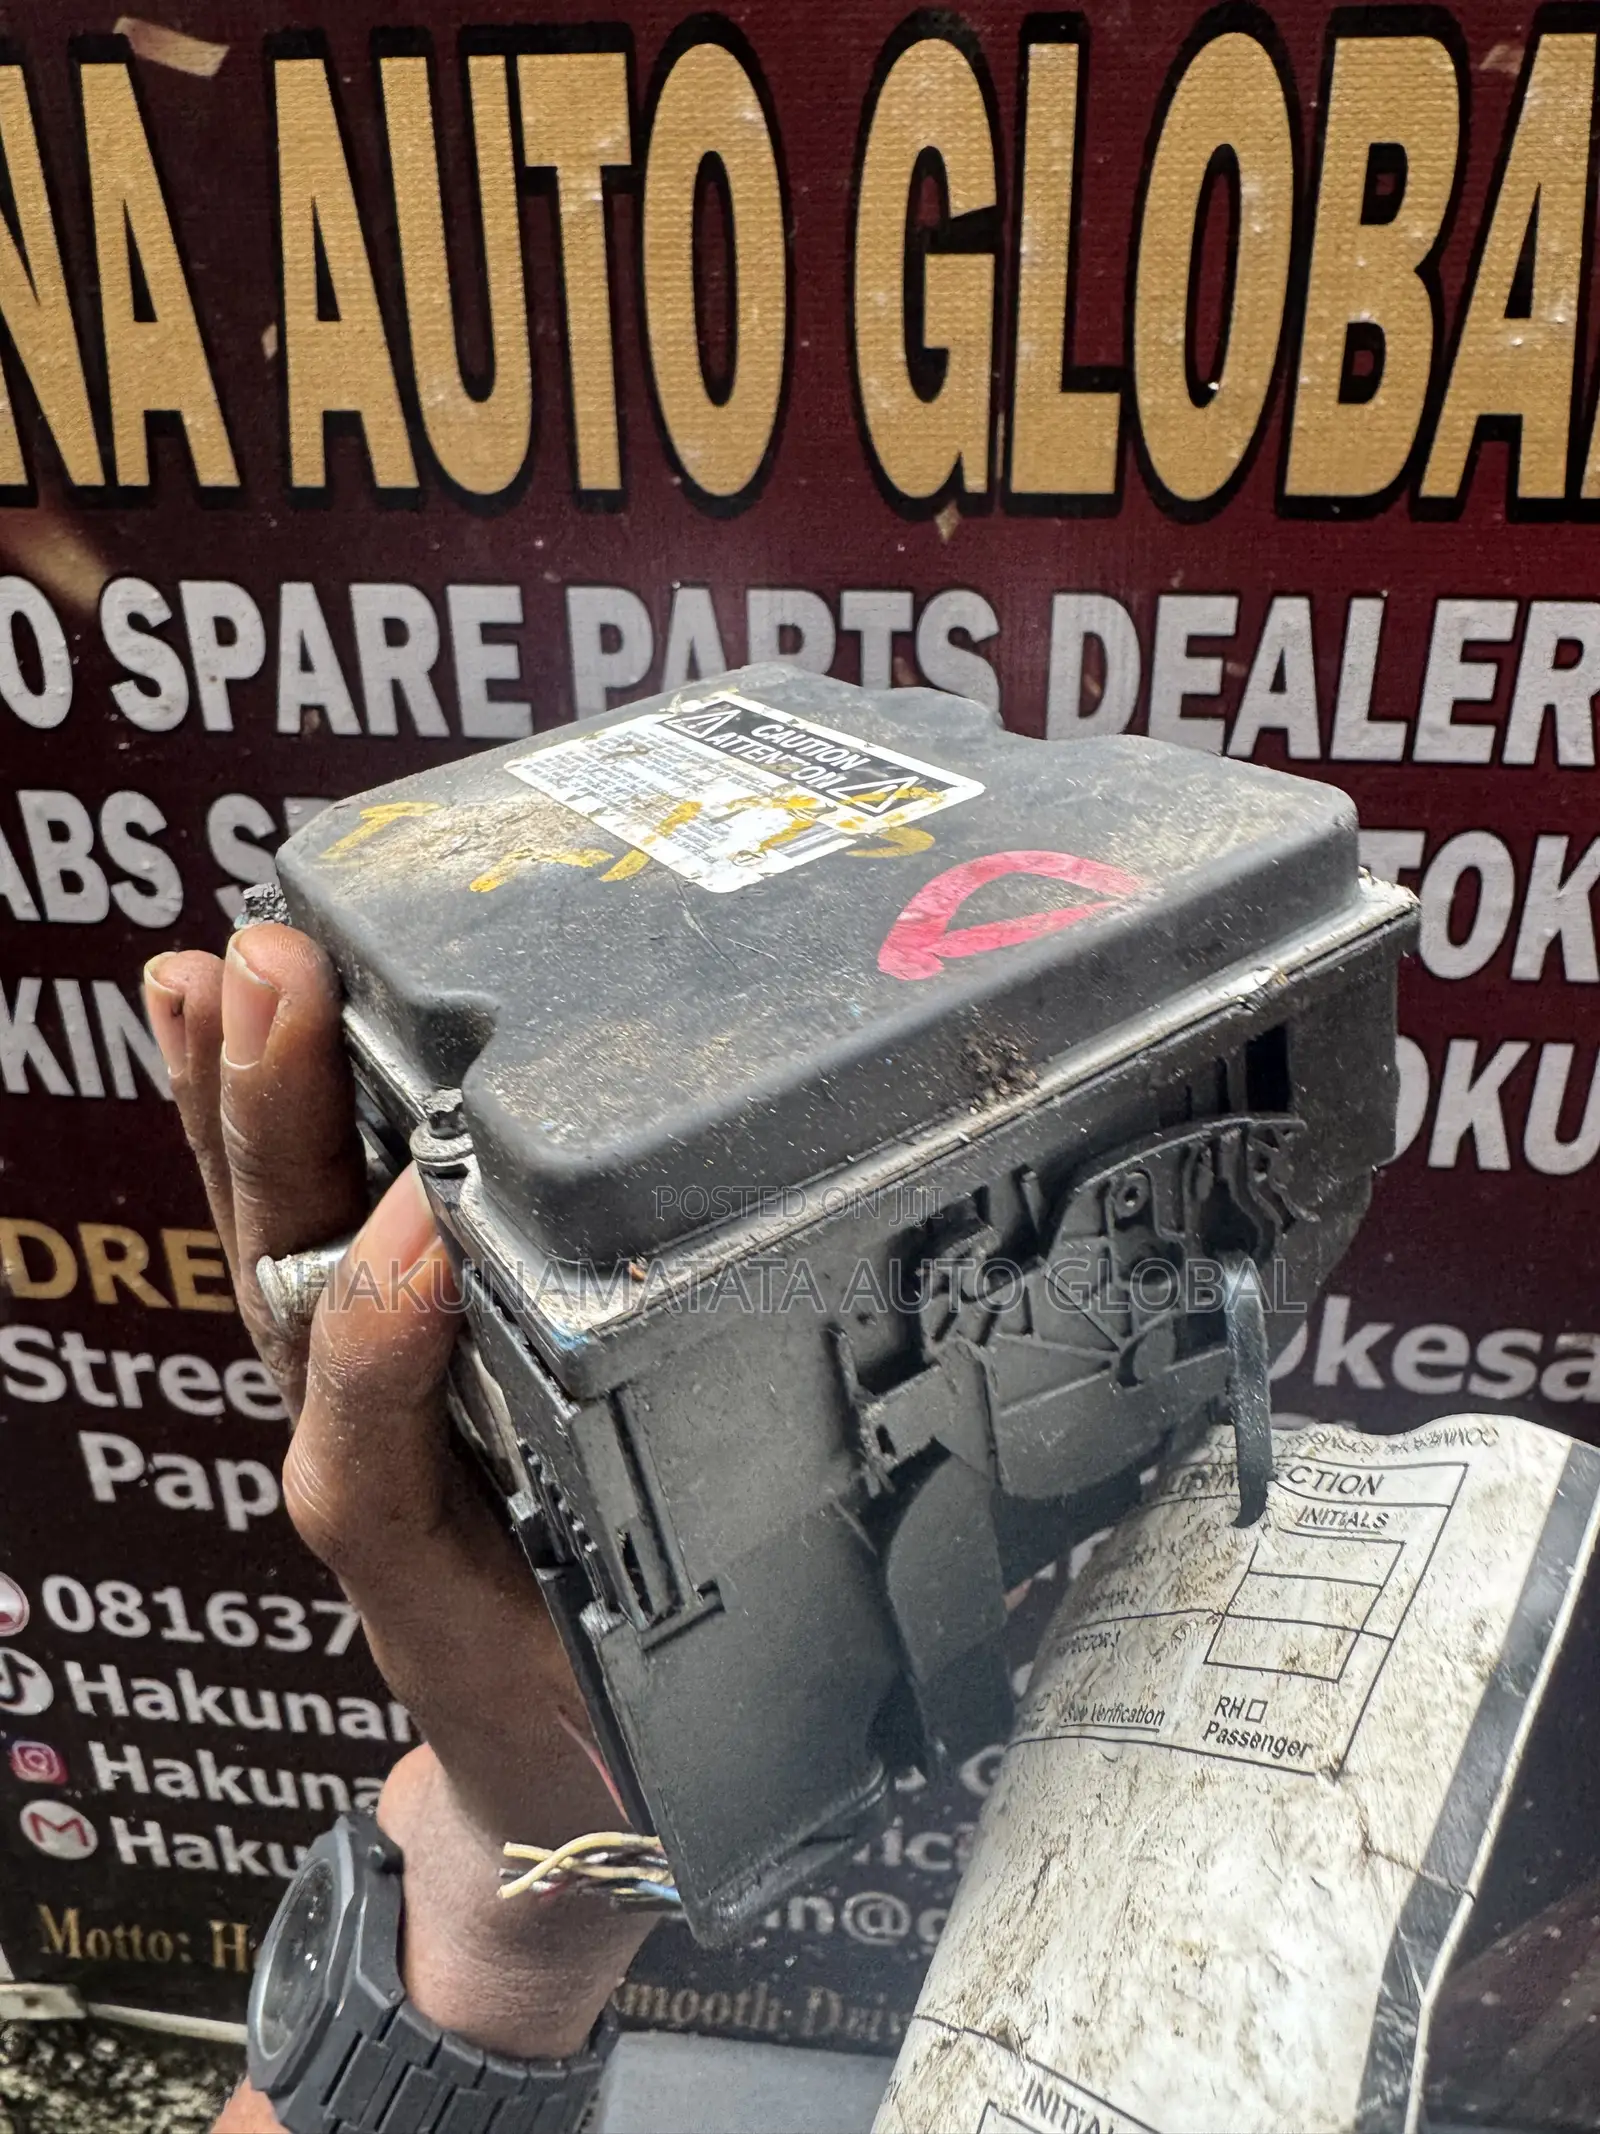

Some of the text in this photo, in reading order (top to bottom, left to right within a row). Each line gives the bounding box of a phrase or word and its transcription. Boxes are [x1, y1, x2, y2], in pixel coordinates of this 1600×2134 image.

[272, 42, 787, 497] AUTO
[853, 31, 1600, 501] GLOBA
[100, 577, 533, 738] SPARE
[1045, 591, 1600, 767] DEALER
[704, 731, 848, 790] ATTENON
[751, 723, 871, 772] CAUTION
[0, 1217, 236, 1313] DRE
[0, 1324, 290, 1421] Stree
[78, 1430, 280, 1532] Pap
[1296, 1504, 1390, 1531] INITIALS
[42, 1574, 362, 1657] 081637
[1202, 1720, 1313, 1760] Passenger
[1214, 1695, 1246, 1721] RH
[109, 1815, 309, 1879] Haku
[37, 1904, 262, 1973] Motto: H
[1022, 2076, 1115, 2134] INITIA
